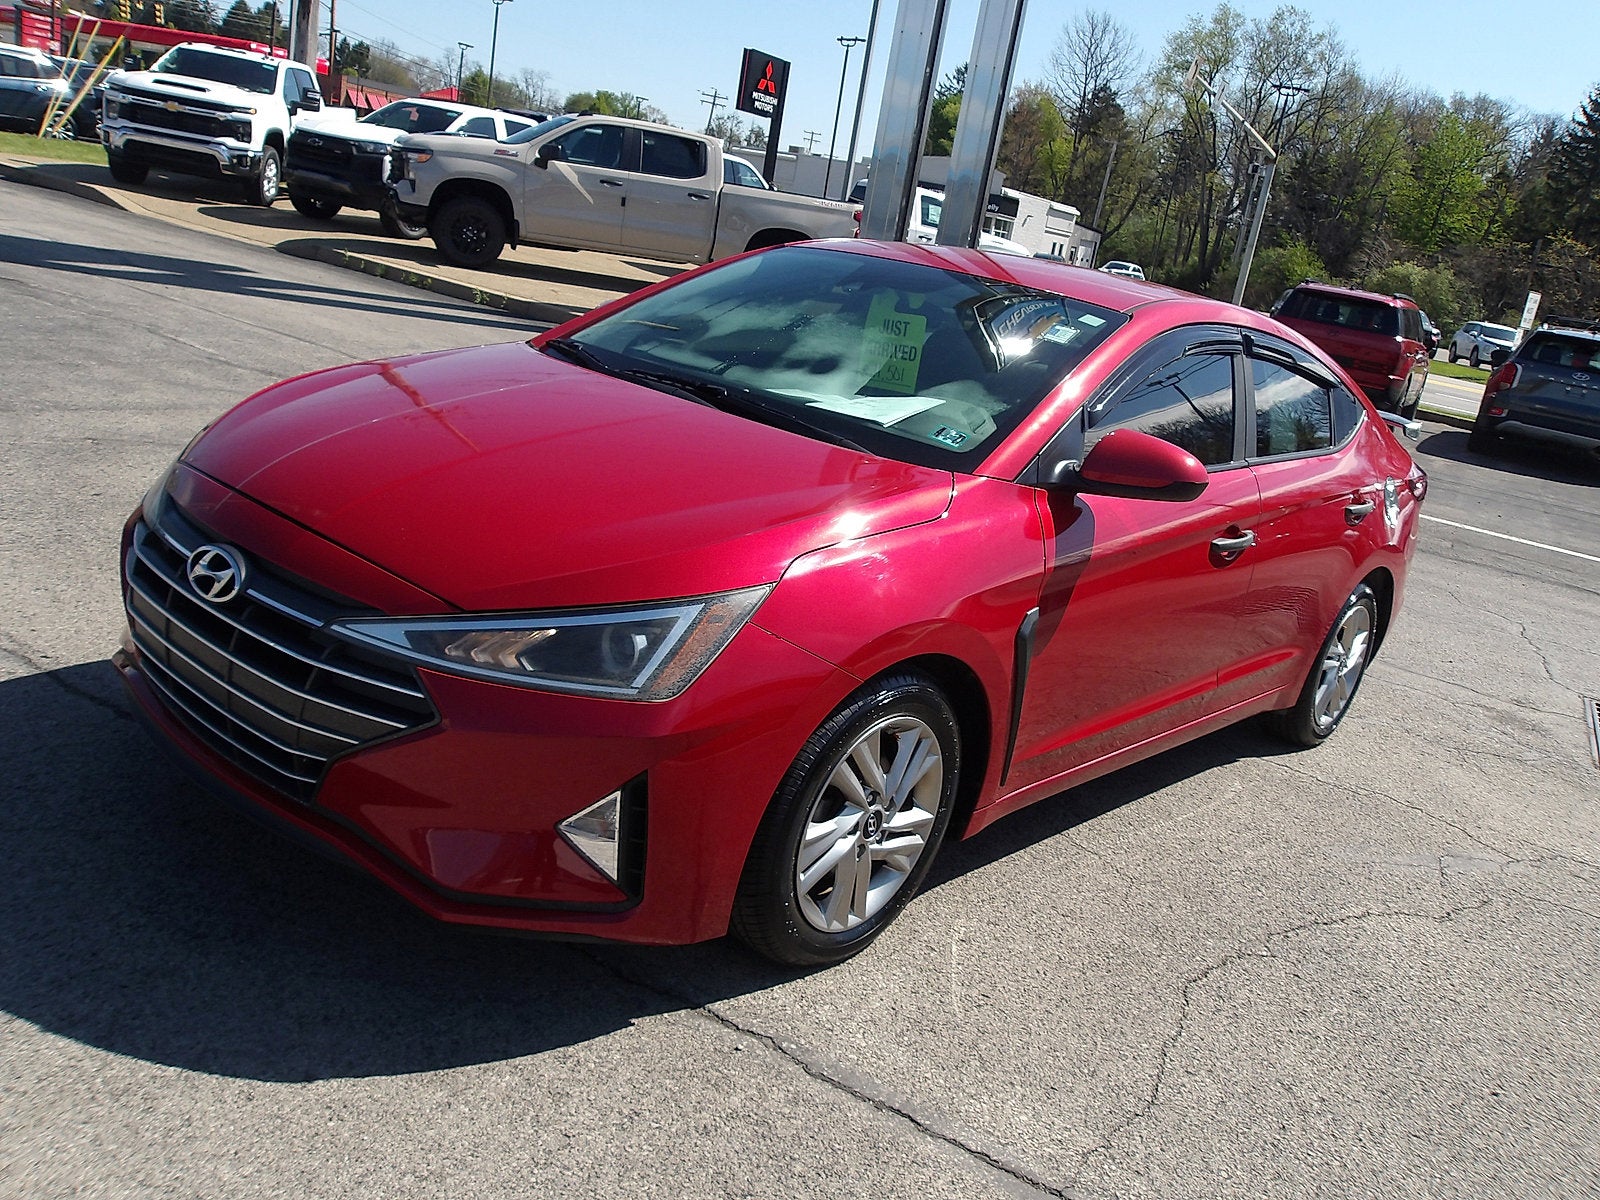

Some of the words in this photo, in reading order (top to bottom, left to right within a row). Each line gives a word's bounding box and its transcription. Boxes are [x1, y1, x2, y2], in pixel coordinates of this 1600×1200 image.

[752, 91, 778, 105] MITSUBISHI
[754, 101, 774, 113] MOTORS
[879, 318, 911, 337] JUST
